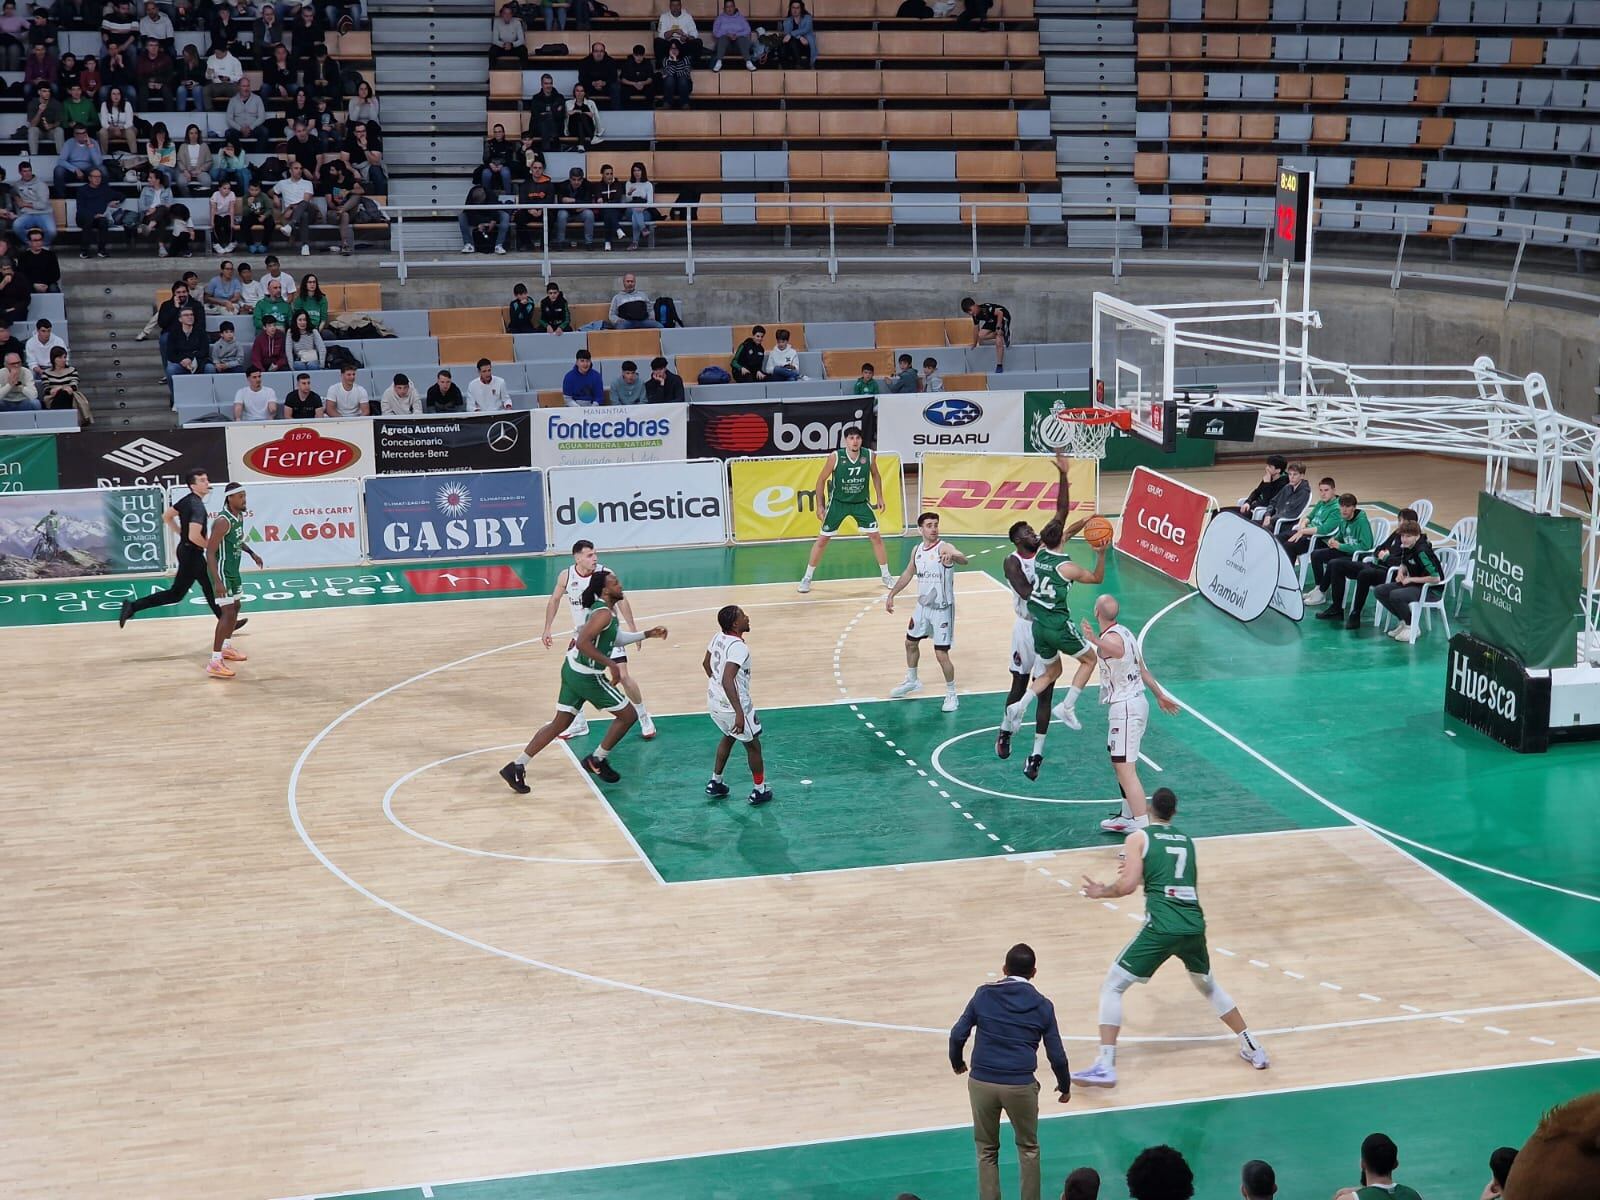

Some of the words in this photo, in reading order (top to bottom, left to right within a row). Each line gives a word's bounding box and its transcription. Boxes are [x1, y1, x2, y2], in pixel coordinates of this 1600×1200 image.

[1280, 173, 1297, 192] 8:40
[291, 433, 312, 441] 1876
[381, 424, 412, 435] Ágreda
[414, 423, 461, 434] Automóvil
[548, 415, 670, 440] Fontecabras
[381, 438, 443, 447] Concesionario
[559, 442, 583, 450] AGUA
[584, 441, 621, 449] MINERAL
[623, 440, 661, 448] NATURAL
[913, 433, 990, 446] SUBARU
[262, 447, 347, 468] Ferrer
[381, 449, 450, 459] Mercedes-Benz
[848, 466, 862, 476] 77
[937, 480, 1080, 511] DHL
[292, 507, 315, 516] CASH
[316, 507, 324, 515] &
[325, 506, 354, 515] CARRY
[245, 517, 356, 543] ARAGÓN
[383, 516, 529, 552] GASBY
[1477, 544, 1524, 582] Lobe
[1208, 573, 1249, 610] Aramóvil
[57, 600, 123, 612] de
[1450, 650, 1517, 722] Huesca
[1165, 847, 1187, 878] 7
